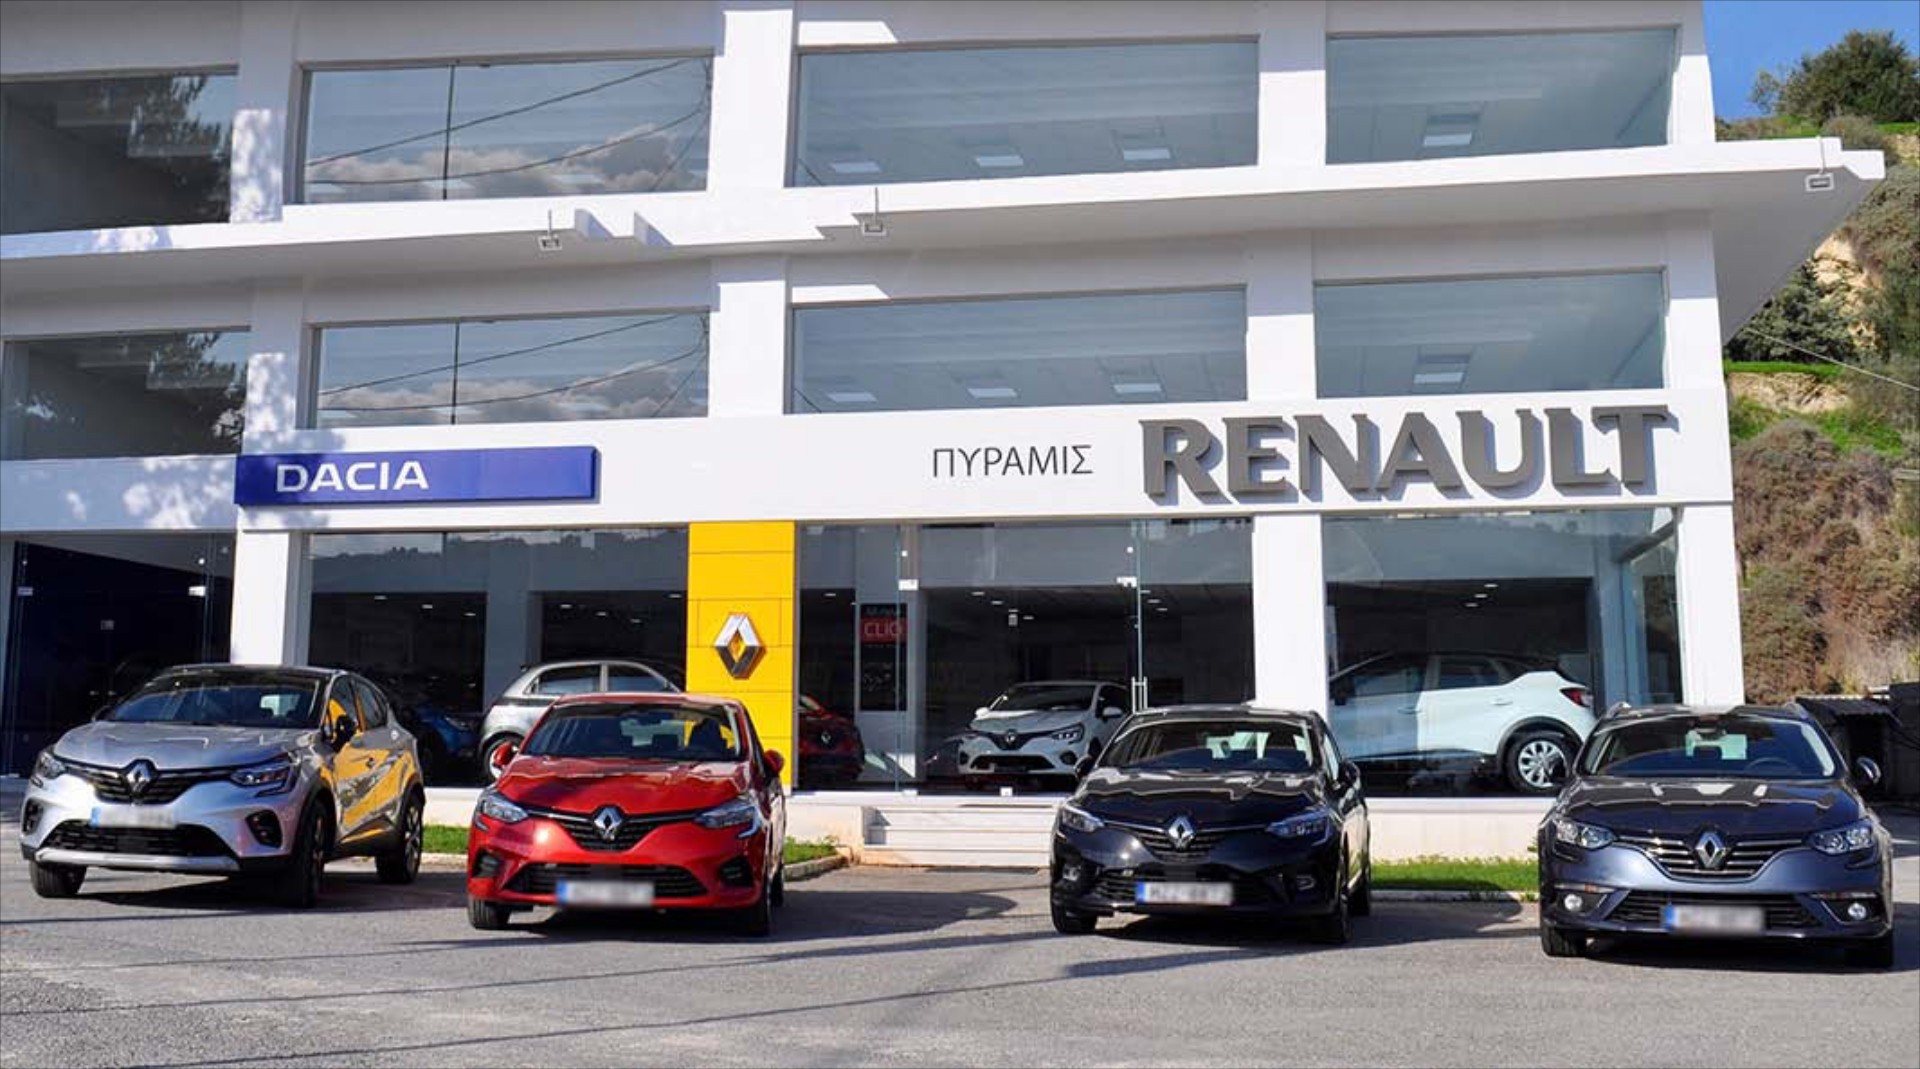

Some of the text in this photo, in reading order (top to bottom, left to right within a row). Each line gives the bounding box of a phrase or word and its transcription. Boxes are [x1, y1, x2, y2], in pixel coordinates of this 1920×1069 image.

[933, 444, 1093, 477] ΠΥΡΑΜΙΣ
[1138, 405, 1671, 497] RENAULT
[276, 460, 429, 492] DACIA
[863, 622, 903, 637] CLIO
